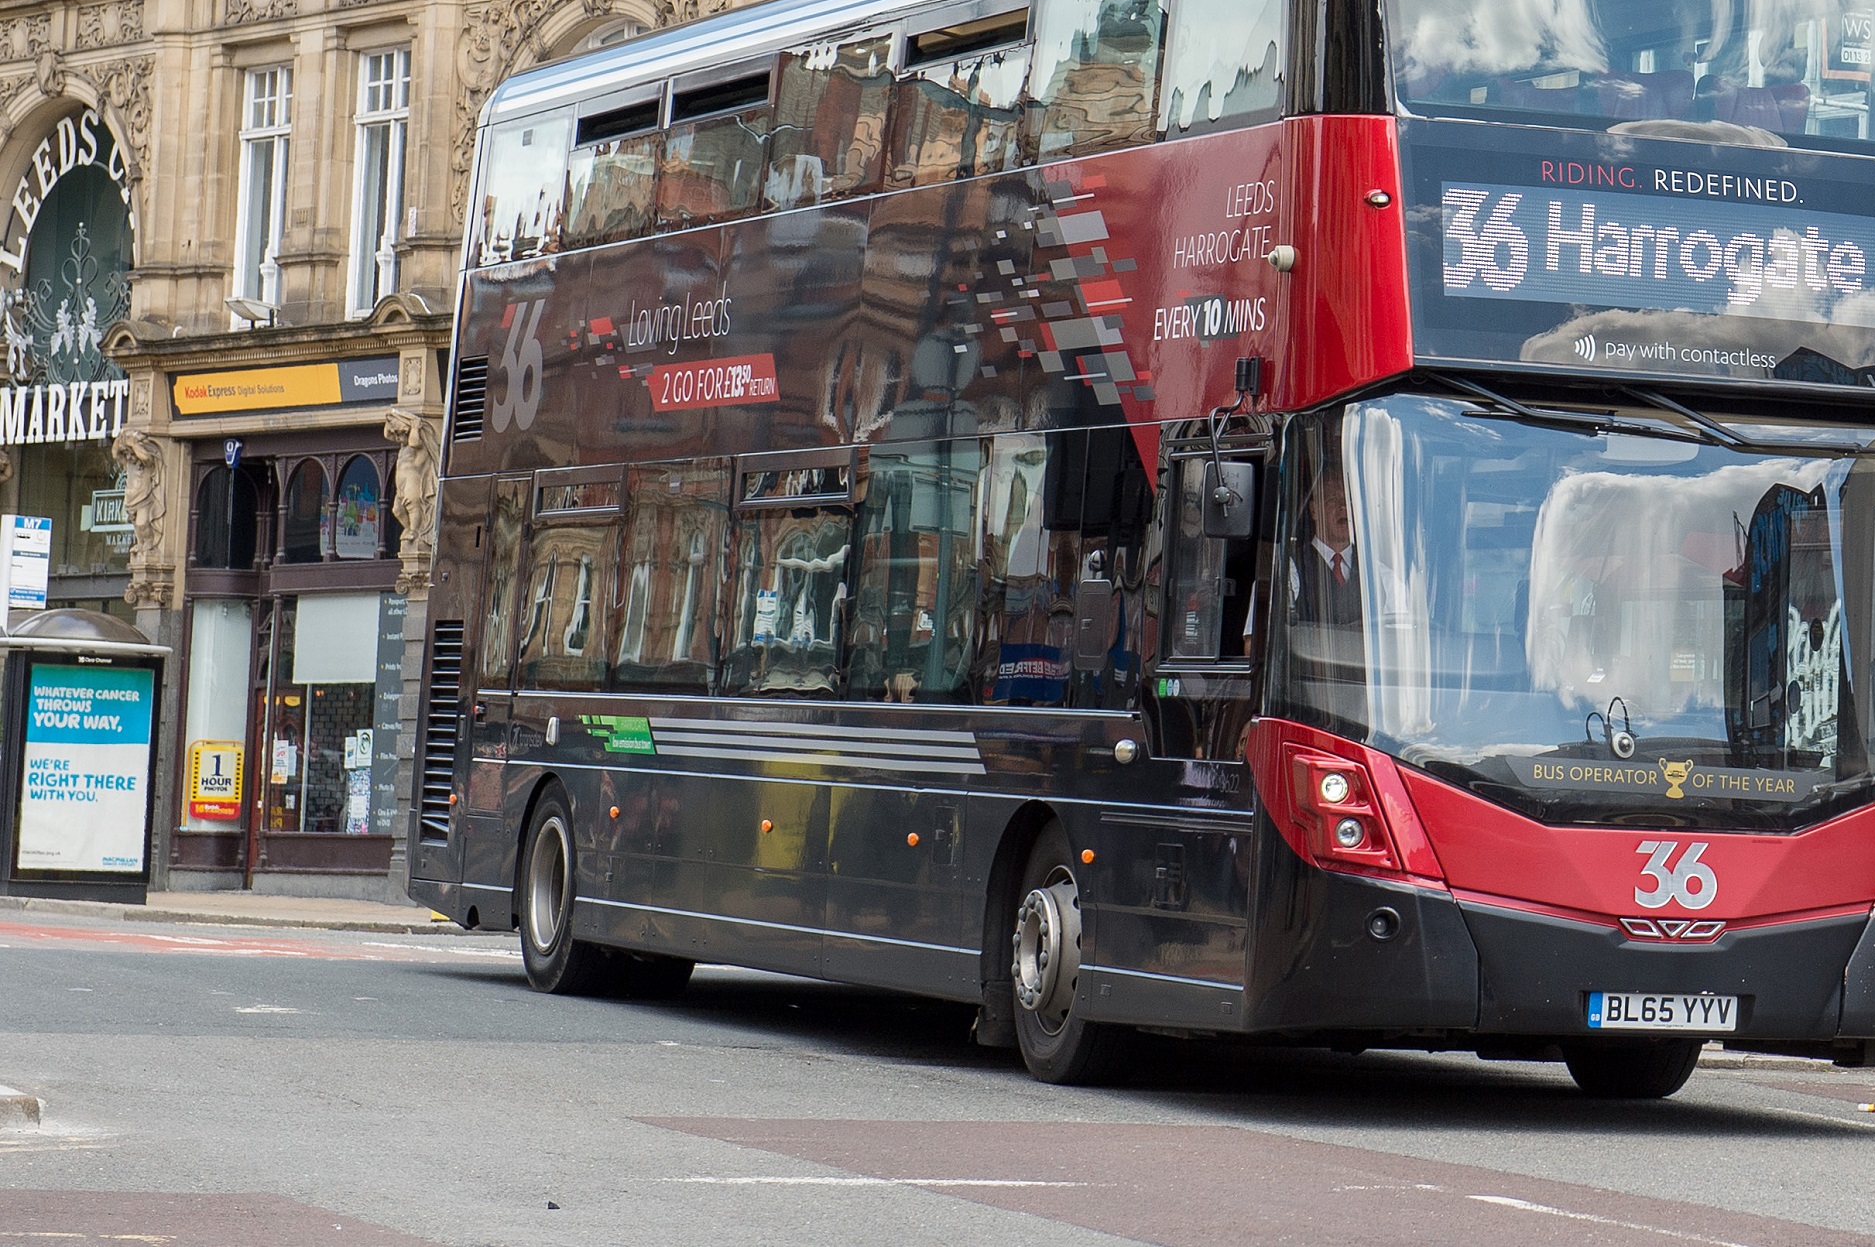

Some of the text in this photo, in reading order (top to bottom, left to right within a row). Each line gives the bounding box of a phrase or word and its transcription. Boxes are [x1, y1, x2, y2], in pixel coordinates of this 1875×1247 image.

[0, 108, 99, 274] LEEDS
[1541, 160, 1804, 205] RIDING. REDEFINED.
[1226, 179, 1276, 218] LEEDS
[1173, 225, 1272, 269] HARROGATE
[1442, 188, 1866, 306] 36 Harrogate
[628, 280, 732, 355] Loving Leeds
[1153, 297, 1266, 341] EVERY 10 MINS
[491, 298, 546, 433] 36
[1604, 342, 1777, 370] pay with contactless
[184, 372, 398, 400] Kodak Express Digital Solutions Dragons Photos
[660, 372, 670, 403] 2
[673, 369, 692, 403] GO
[697, 367, 723, 402] FOR
[750, 377, 776, 397] RETURN
[23, 518, 42, 530] M7
[34, 686, 140, 702] WHATEVER CANCER
[36, 698, 92, 713] THROWS
[33, 711, 123, 732] YOUR WAY,
[30, 758, 70, 771] WE'RE
[212, 754, 224, 776] 1
[1533, 764, 1795, 793] BUS OPERATOR OF THE YEAR
[28, 771, 136, 791] RIGHT THERE
[201, 777, 232, 786] HOUR
[69, 789, 99, 802] YOU.
[1634, 840, 1718, 910] 36
[1590, 1012, 1600, 1022] GB
[1606, 995, 1732, 1024] BL65 YYV
